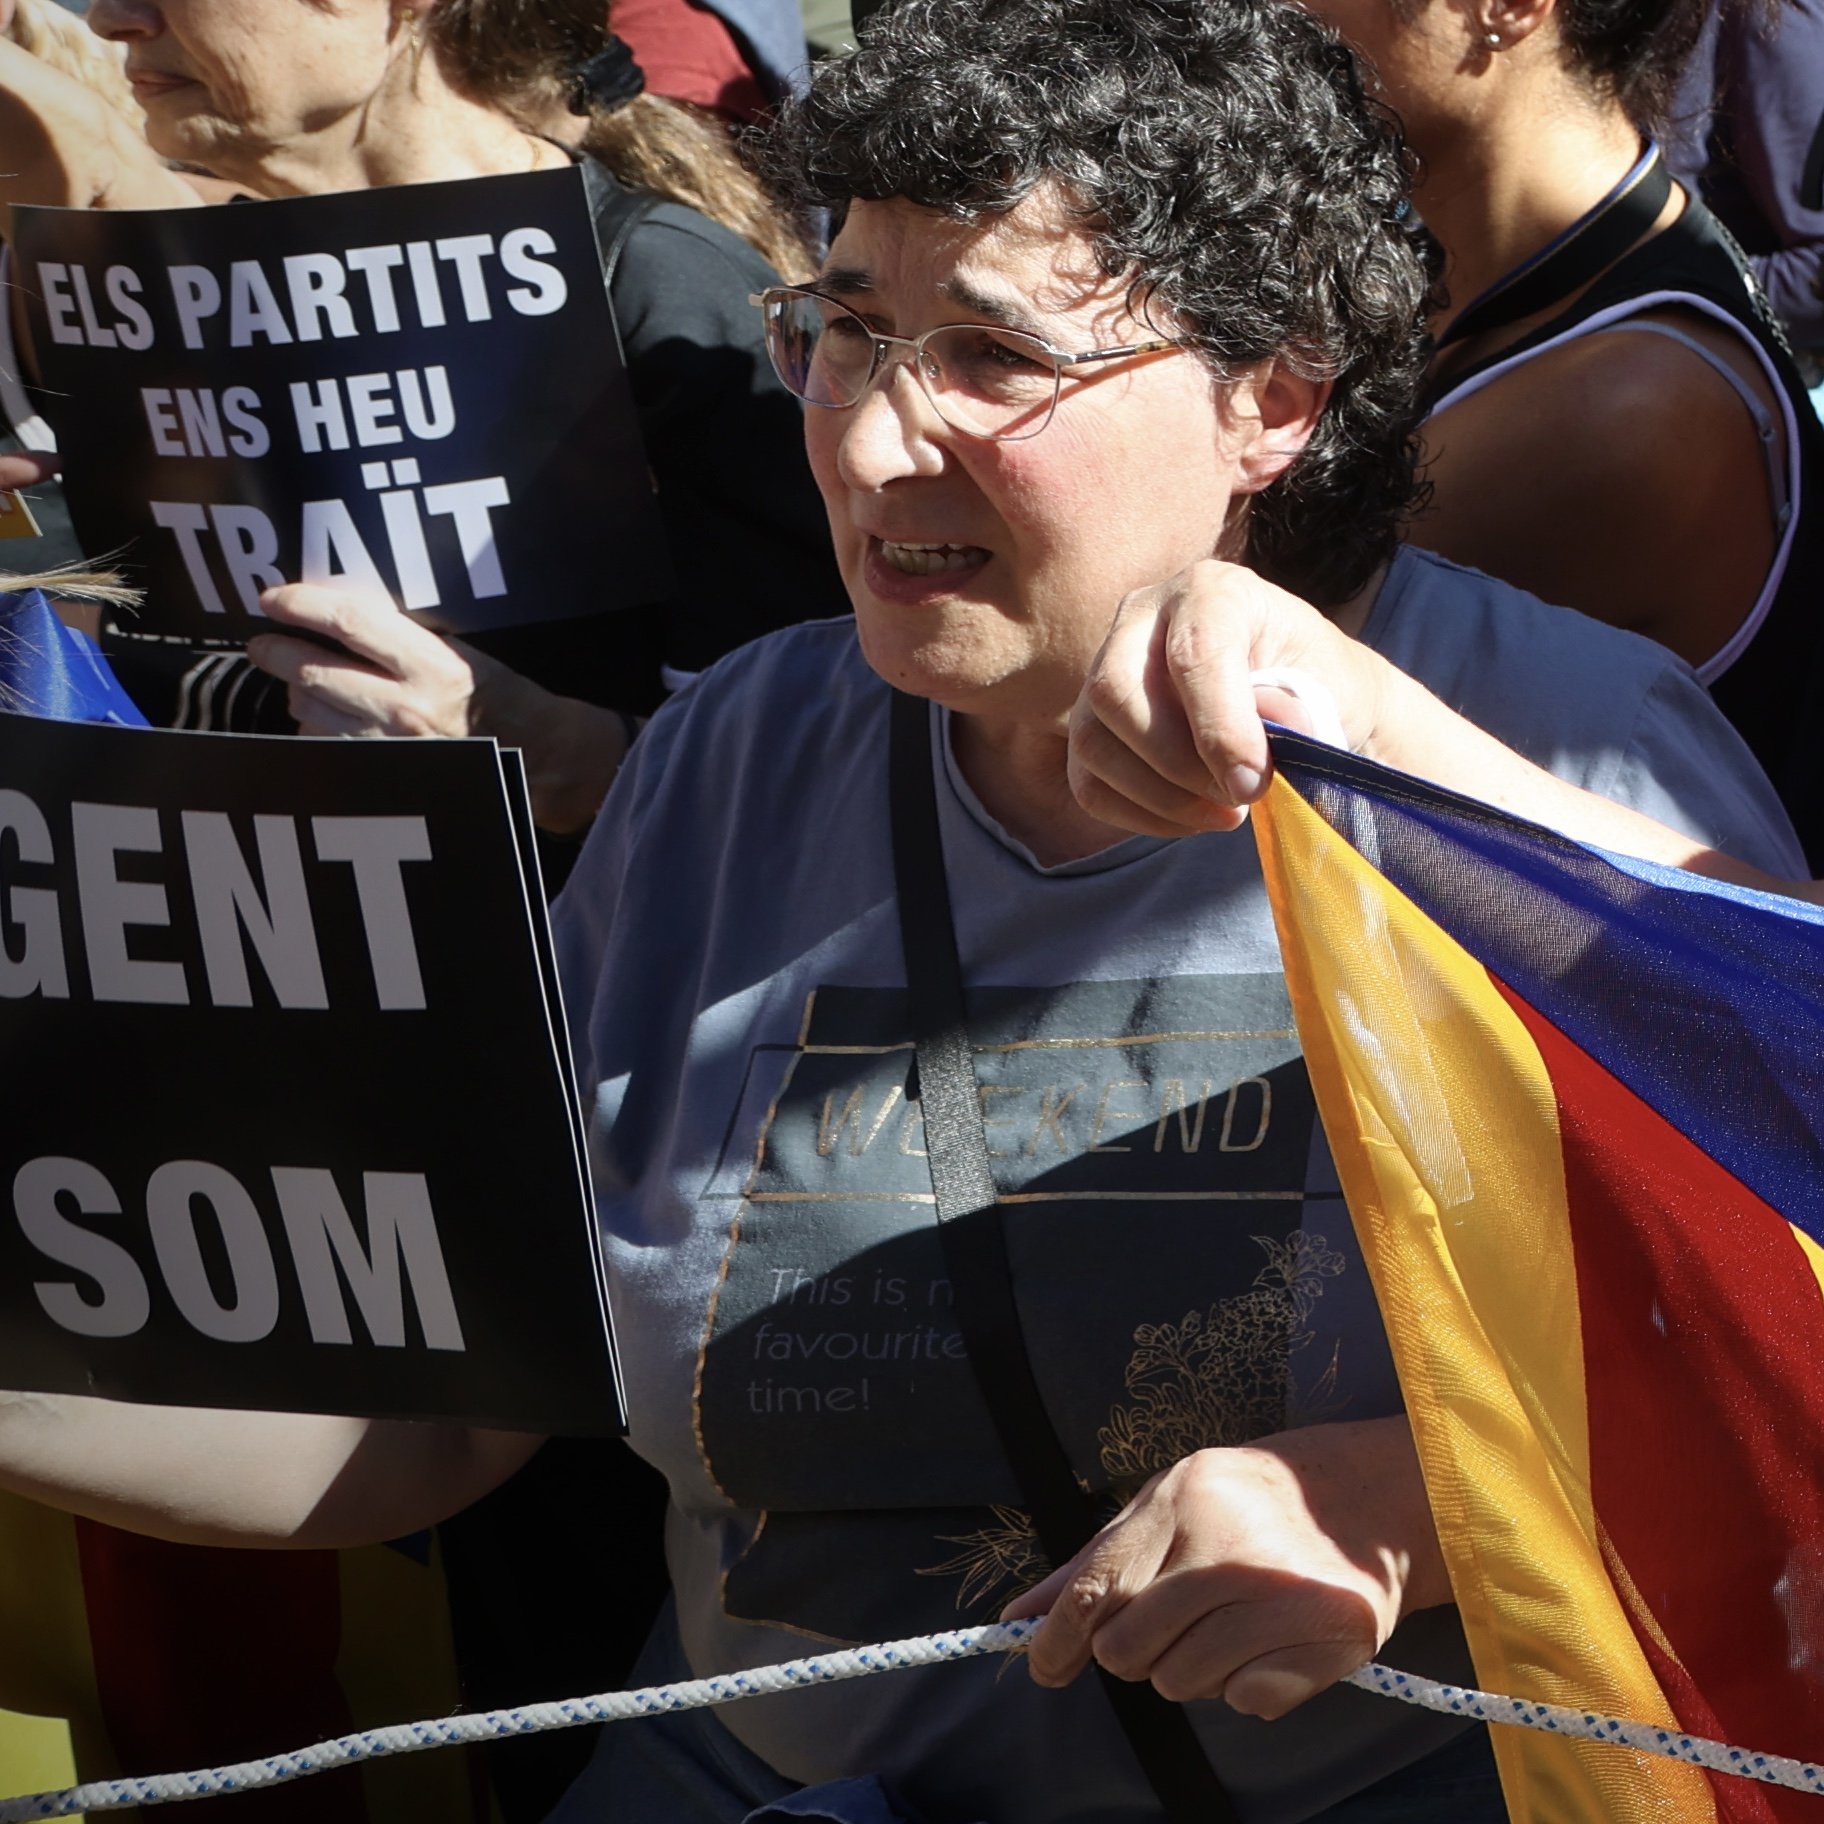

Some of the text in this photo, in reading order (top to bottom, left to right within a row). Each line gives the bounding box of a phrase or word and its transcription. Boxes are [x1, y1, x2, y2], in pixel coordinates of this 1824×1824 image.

[36, 226, 568, 351] ELS PARTITS
[141, 363, 457, 459] ENS HEU
[150, 457, 511, 619] TRAÏT
[12, 1155, 467, 1353] SOM
[771, 1267, 853, 1306] This
[872, 1267, 907, 1307] is
[753, 1322, 969, 1361] favourite
[746, 1377, 871, 1413] time!
